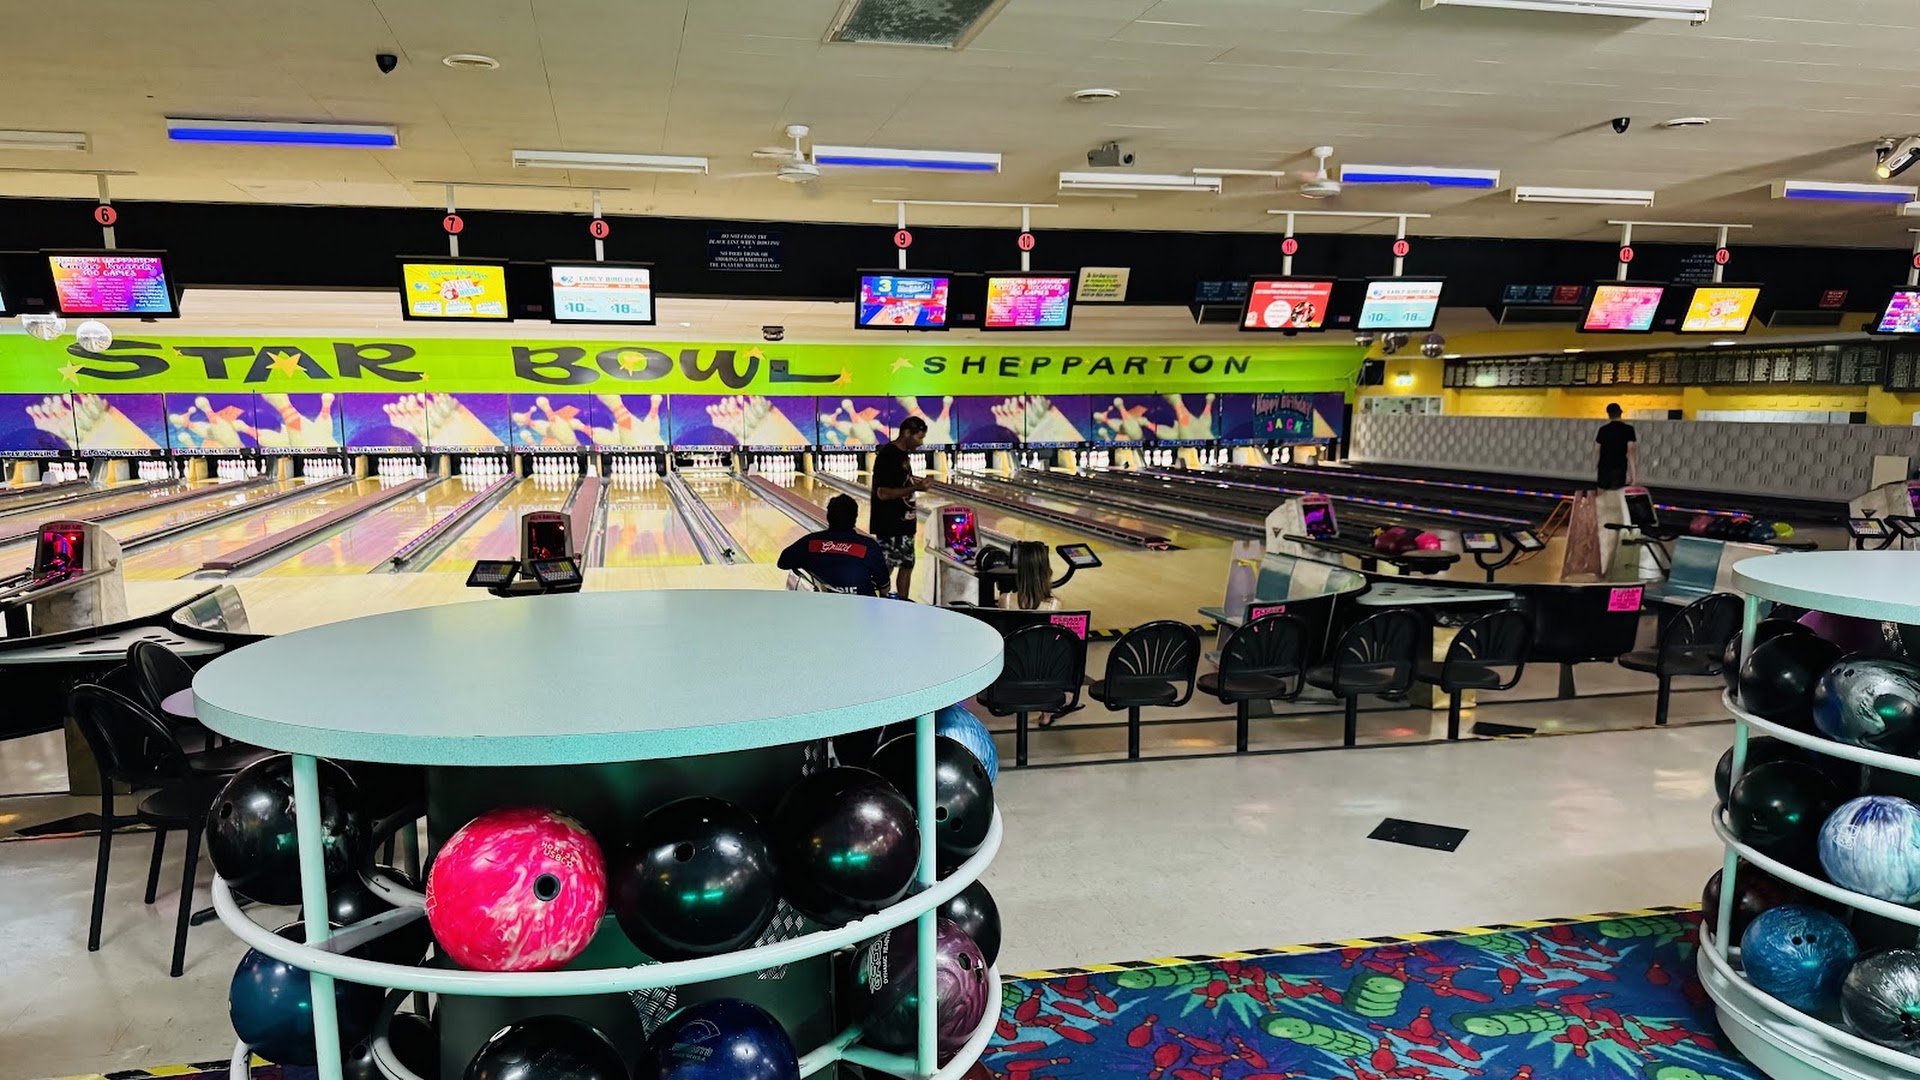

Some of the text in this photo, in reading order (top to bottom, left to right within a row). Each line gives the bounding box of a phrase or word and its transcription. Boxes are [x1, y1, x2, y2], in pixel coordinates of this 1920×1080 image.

[102, 208, 109, 222] 6
[448, 217, 456, 231] 7
[596, 222, 602, 235] 8
[900, 232, 906, 246] 9
[1022, 236, 1030, 248] 10
[1286, 240, 1292, 253] 11
[1398, 242, 1404, 254] 12
[1622, 249, 1630, 260] 13
[878, 280, 892, 292] 3
[565, 302, 585, 312] $10
[611, 304, 630, 313] $18
[66, 340, 1251, 389] STAR BOWL SHEPPARTON
[1256, 394, 1312, 420] Happy Birthday
[1266, 418, 1304, 433] JACK
